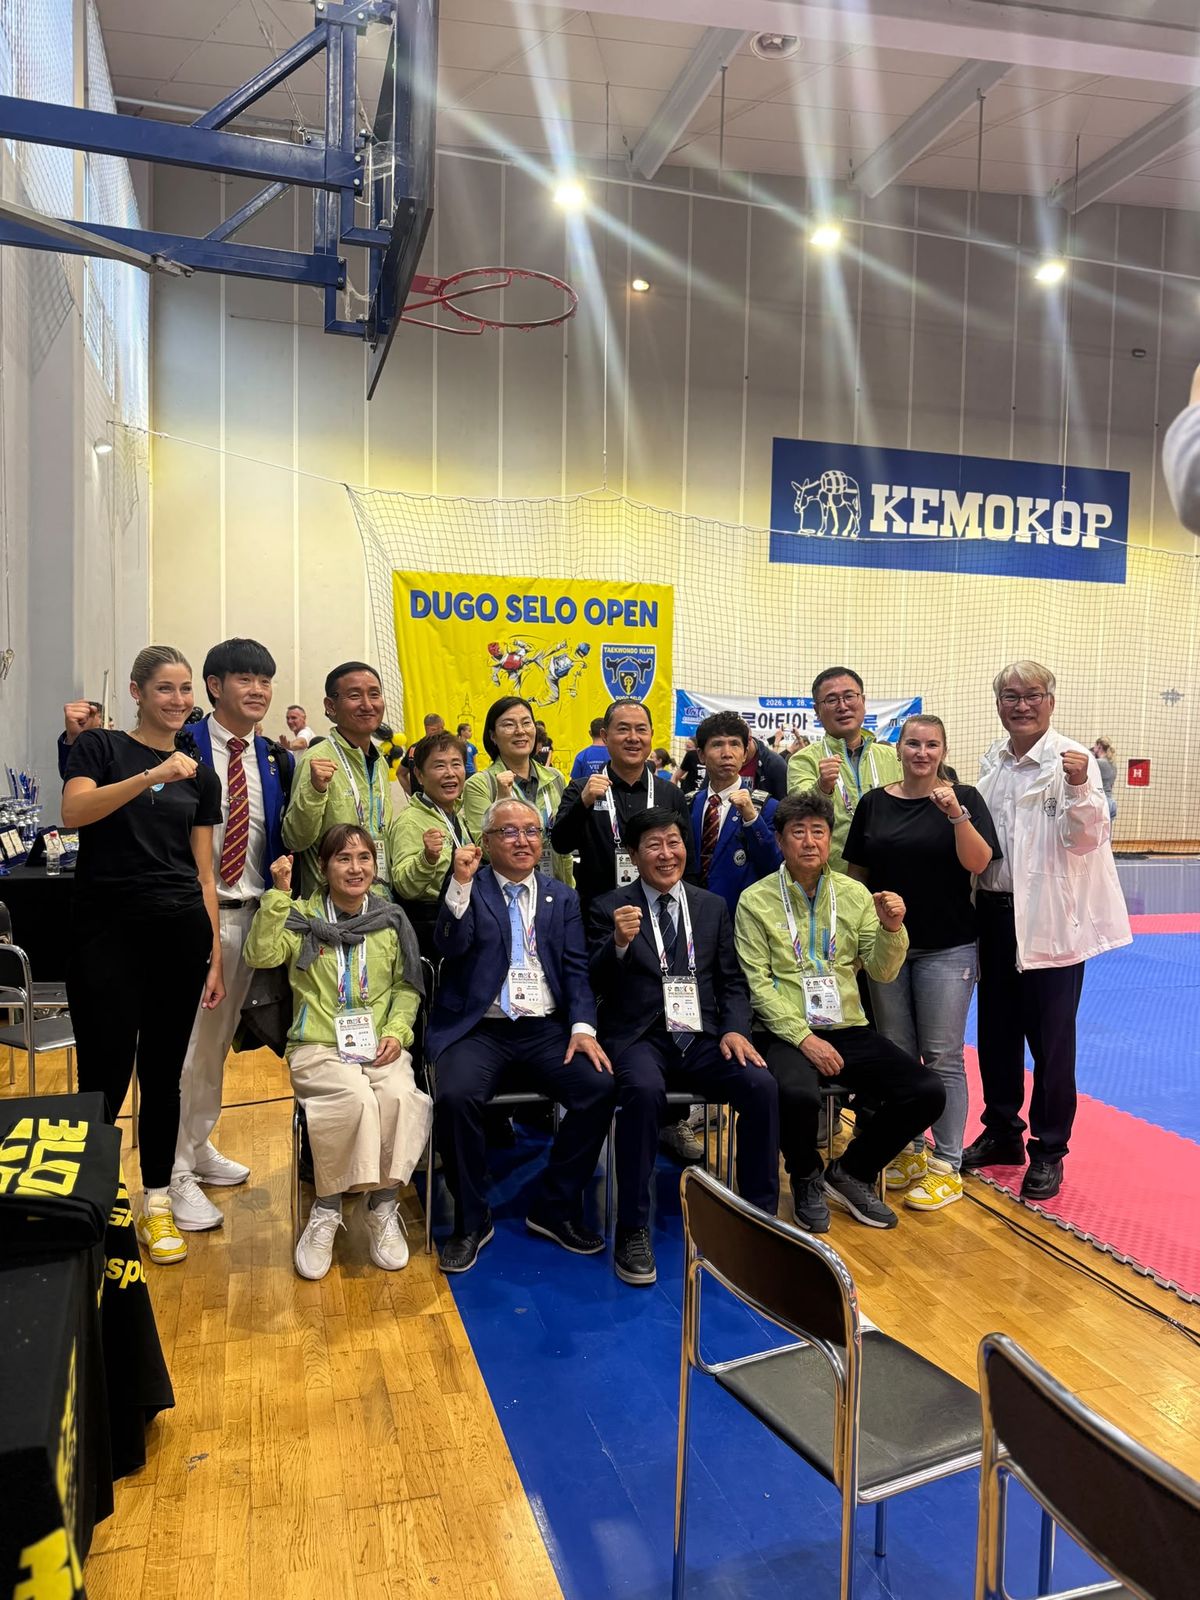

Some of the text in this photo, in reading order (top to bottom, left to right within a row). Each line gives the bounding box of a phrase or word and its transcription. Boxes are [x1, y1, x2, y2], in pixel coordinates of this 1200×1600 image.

[869, 483, 1113, 549] KEMOKOP
[410, 589, 658, 628] DUGO SELO OPEN
[603, 646, 638, 654] TAEKWONDO
[734, 711, 808, 730] 로아티아
